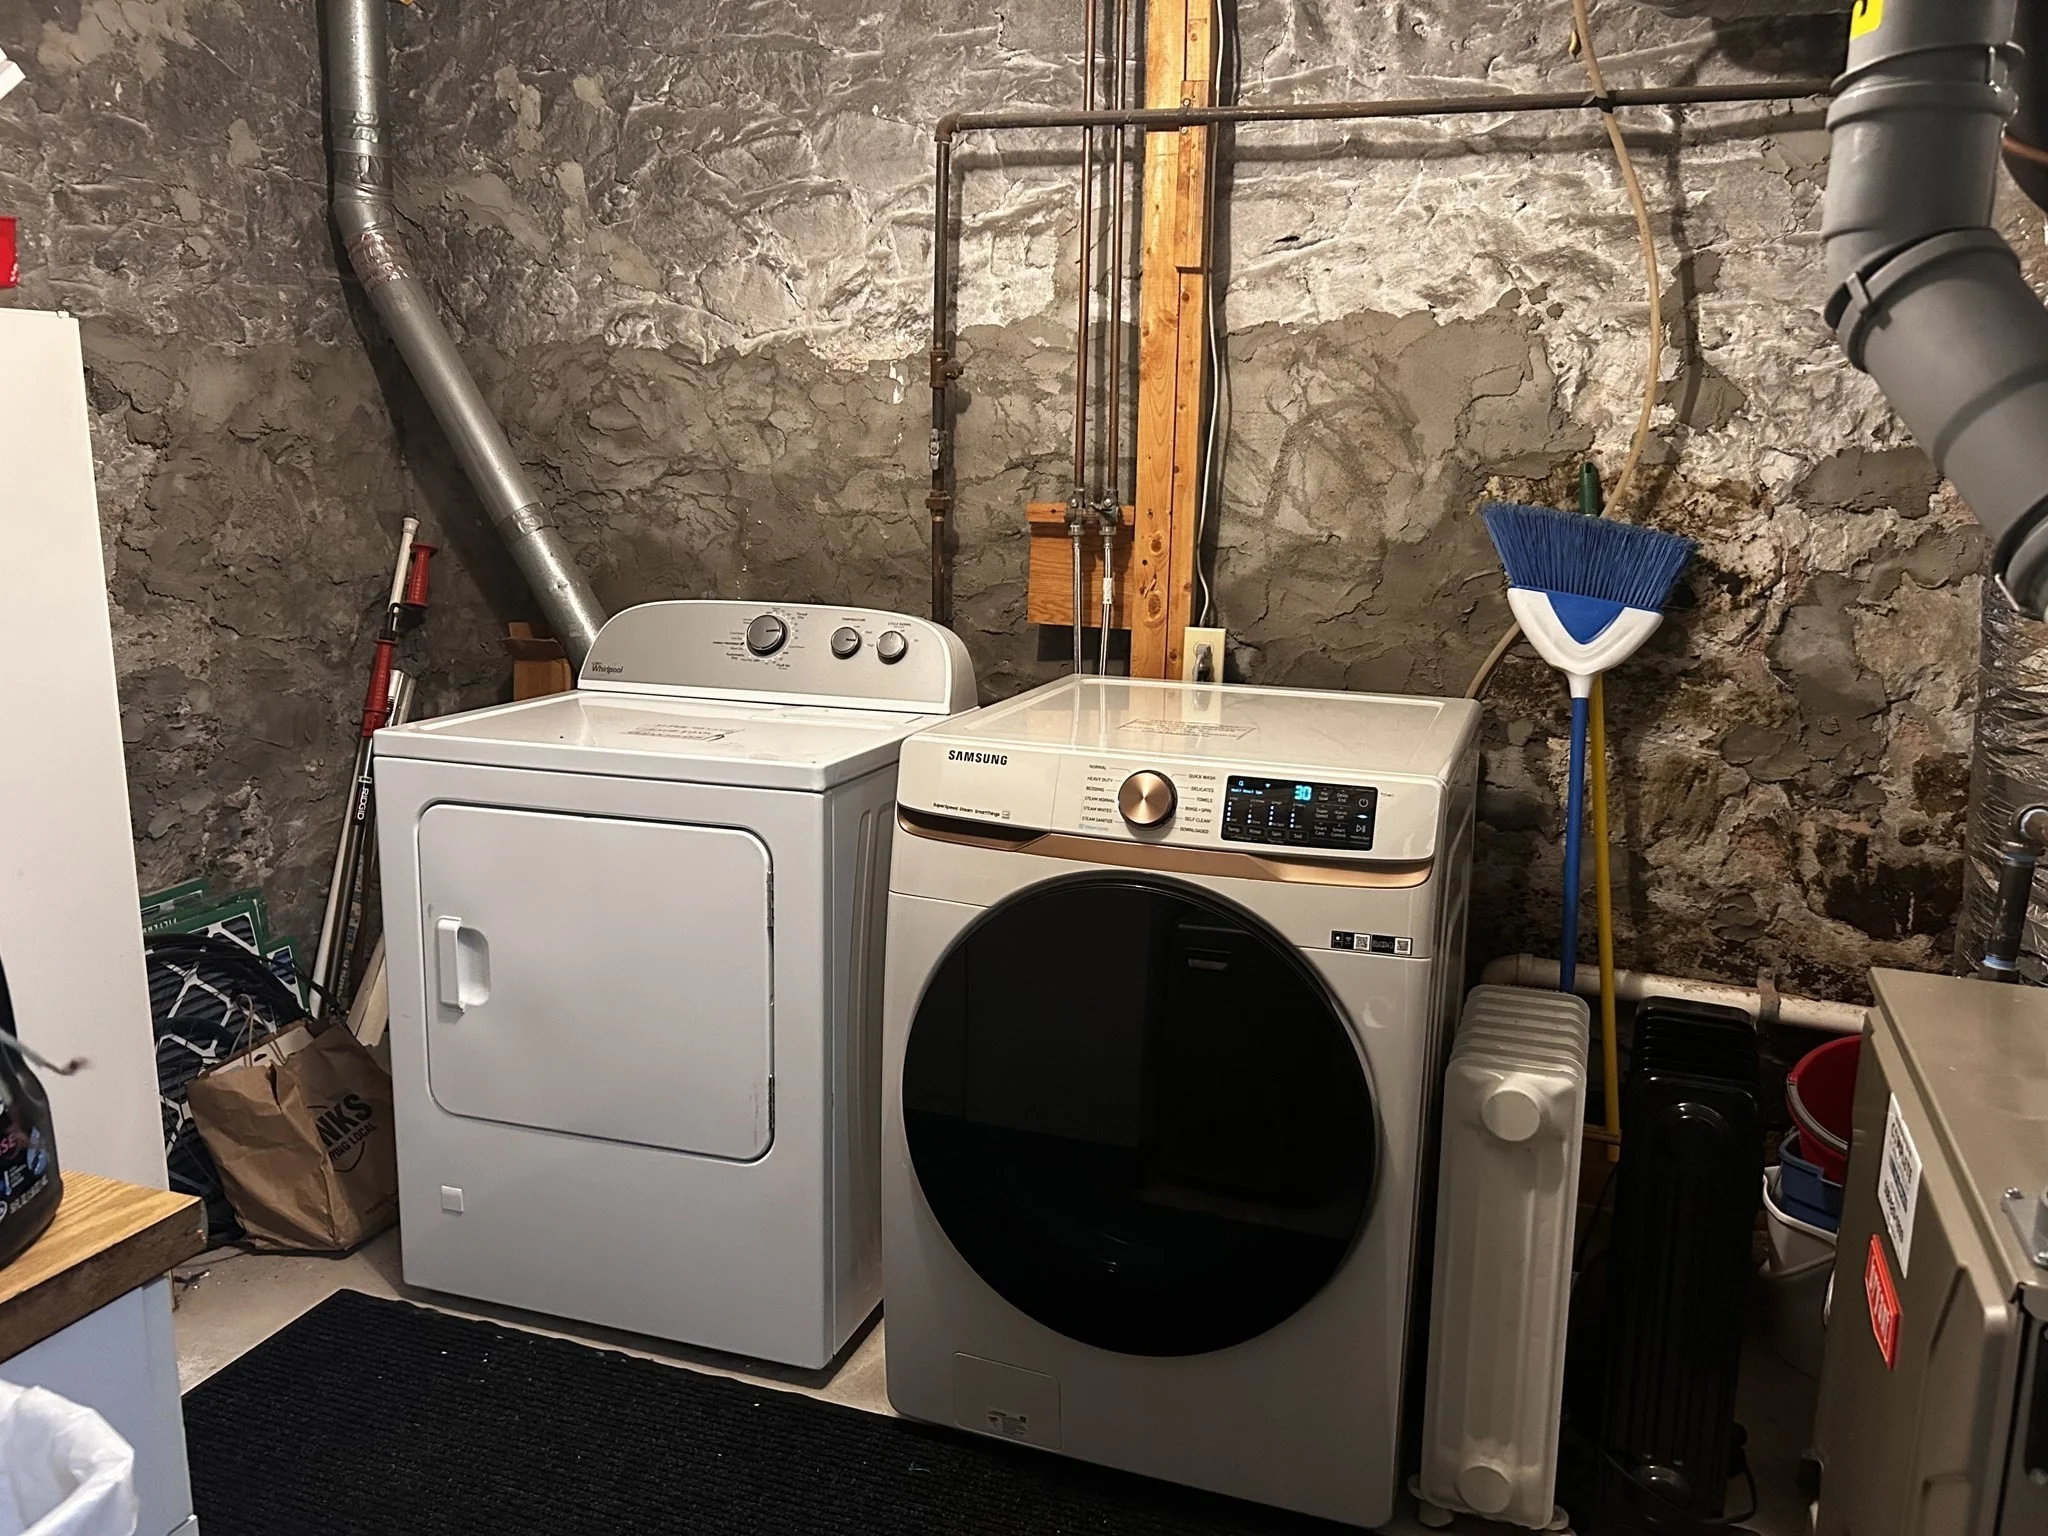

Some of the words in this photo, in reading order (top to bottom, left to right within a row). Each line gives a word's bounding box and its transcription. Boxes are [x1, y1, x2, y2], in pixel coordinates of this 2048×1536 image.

[592, 664, 623, 674] Whirlpool
[948, 749, 1008, 766] SAMSUNG
[1294, 784, 1312, 800] 30
[357, 787, 370, 821] RIDGID
[933, 802, 958, 812] SuperSpeed
[975, 809, 1000, 817] SmartThings
[1180, 826, 1209, 834] DOWNLOADED
[348, 1122, 377, 1145] LOCAL
